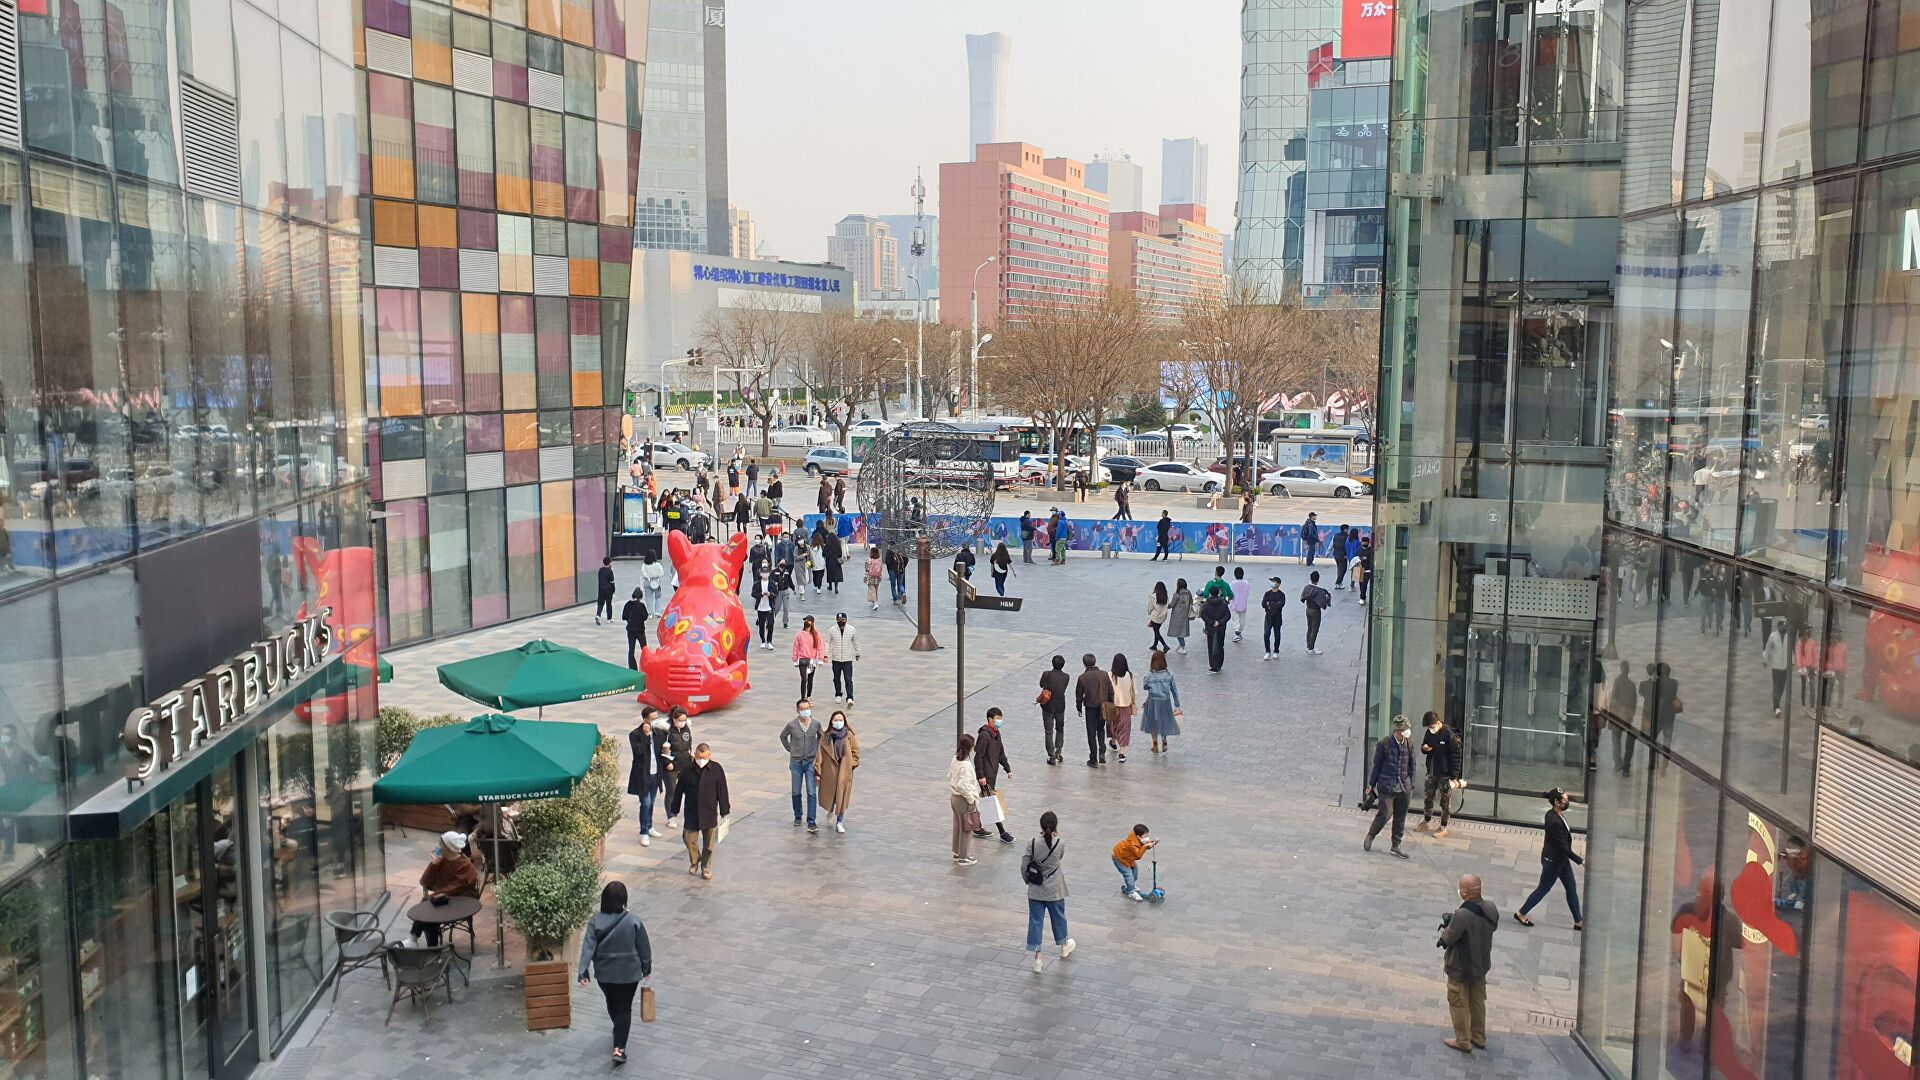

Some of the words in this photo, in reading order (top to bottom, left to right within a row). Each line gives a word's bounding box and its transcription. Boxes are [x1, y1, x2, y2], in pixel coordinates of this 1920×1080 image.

[124, 606, 333, 778] STARBUCKS
[478, 792, 527, 801] STARBUCKS
[528, 789, 560, 798] COFFEE
